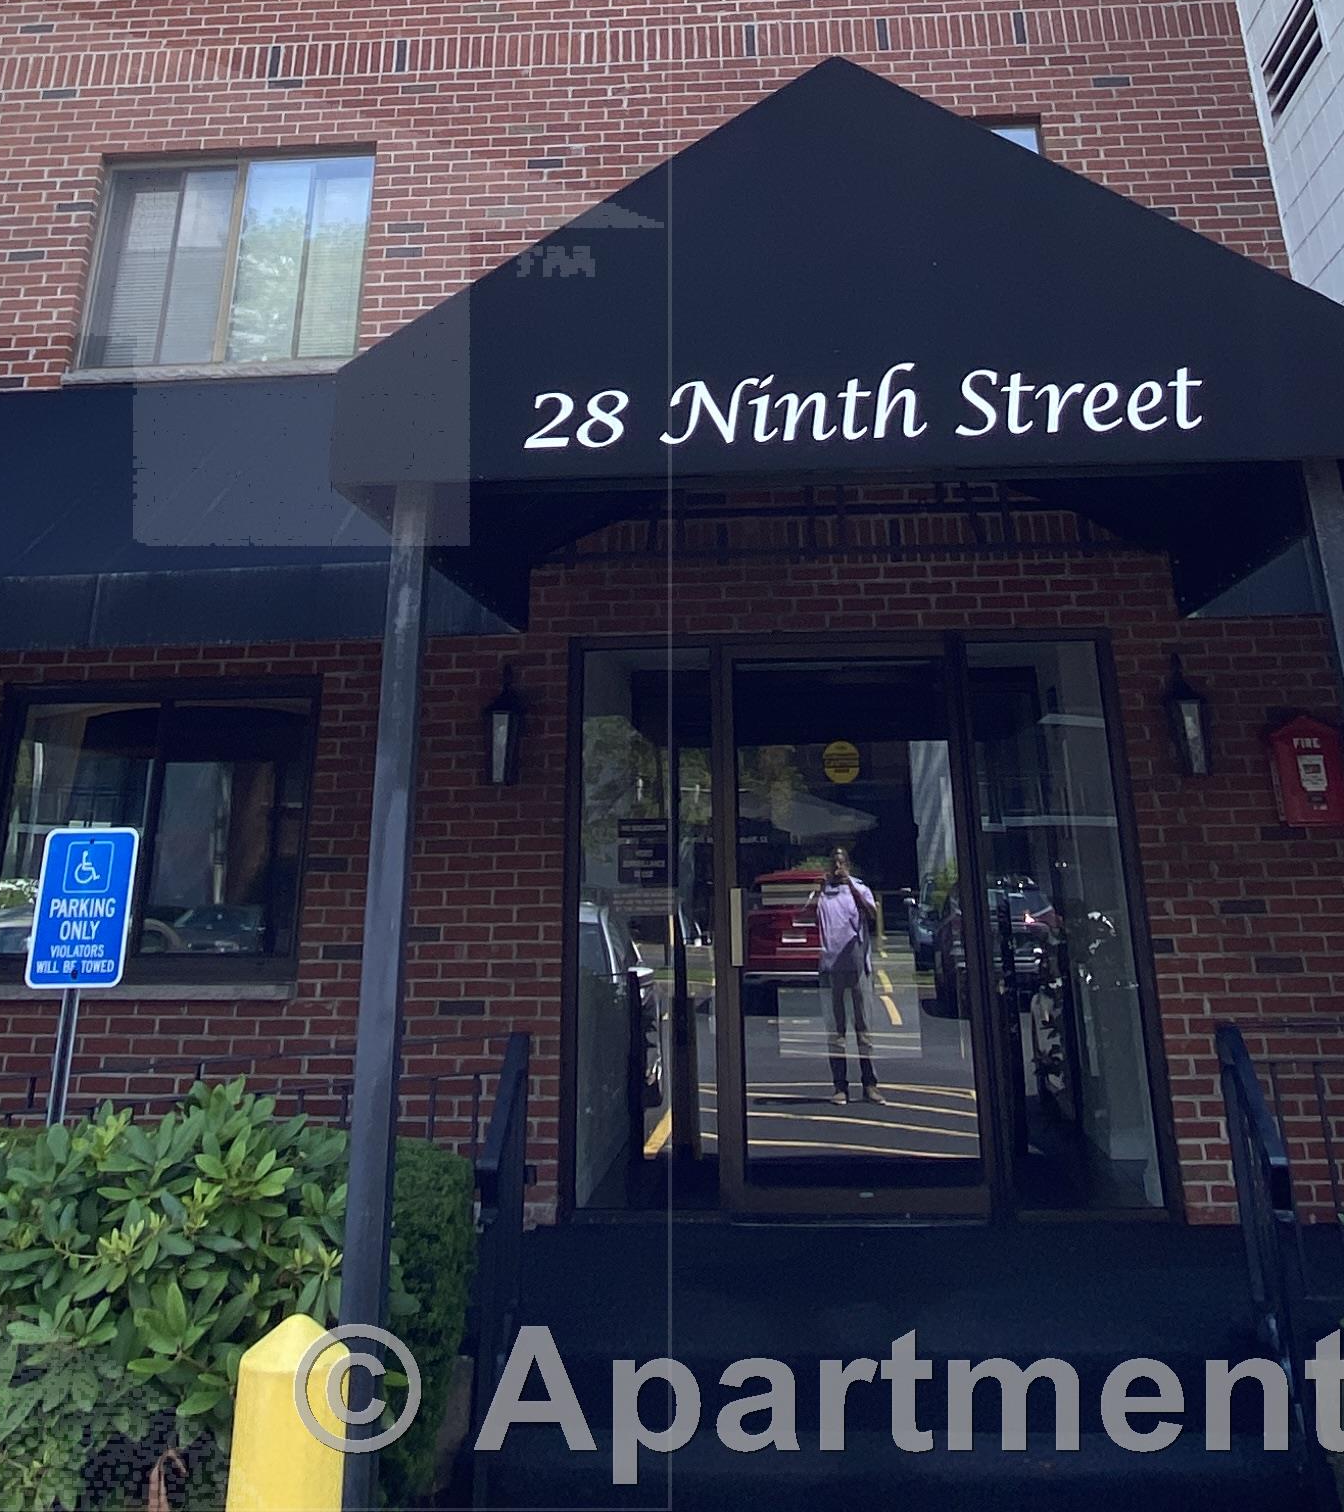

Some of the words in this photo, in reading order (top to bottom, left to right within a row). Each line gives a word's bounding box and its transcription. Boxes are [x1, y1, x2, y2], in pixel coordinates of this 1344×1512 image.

[524, 390, 629, 448] 28
[660, 362, 926, 445] Ninth
[956, 367, 1203, 437] Street
[1293, 738, 1320, 749] FIRE
[49, 898, 116, 918] PARKING
[60, 921, 100, 940] ONLY
[50, 945, 104, 958] VIOLATORS
[36, 961, 59, 973] WILL
[63, 960, 77, 973] BE
[81, 960, 114, 973] TOWED
